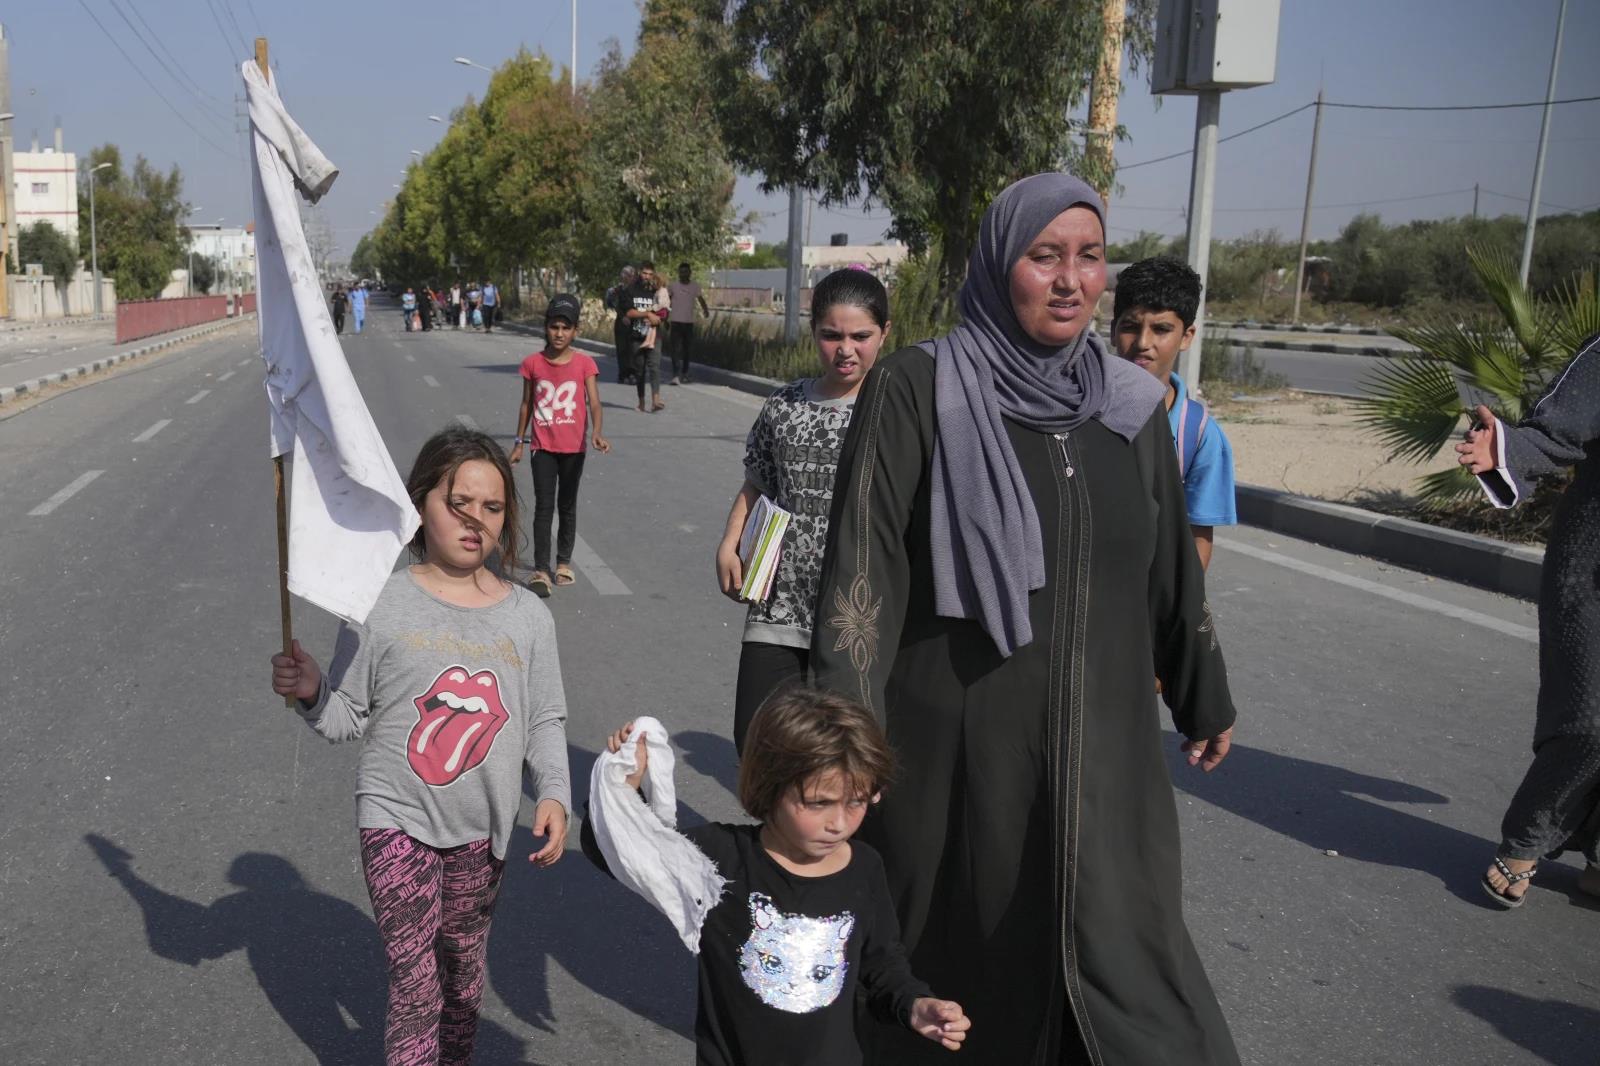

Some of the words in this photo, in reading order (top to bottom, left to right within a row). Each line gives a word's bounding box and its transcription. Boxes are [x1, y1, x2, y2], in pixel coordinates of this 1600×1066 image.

[534, 380, 577, 420] 24
[382, 841, 404, 860] NIKE
[374, 872, 391, 890] NIKE
[399, 880, 420, 900] NIKE
[465, 876, 489, 890] NIKE
[416, 926, 433, 946] NIKE
[411, 960, 432, 981] NIKE
